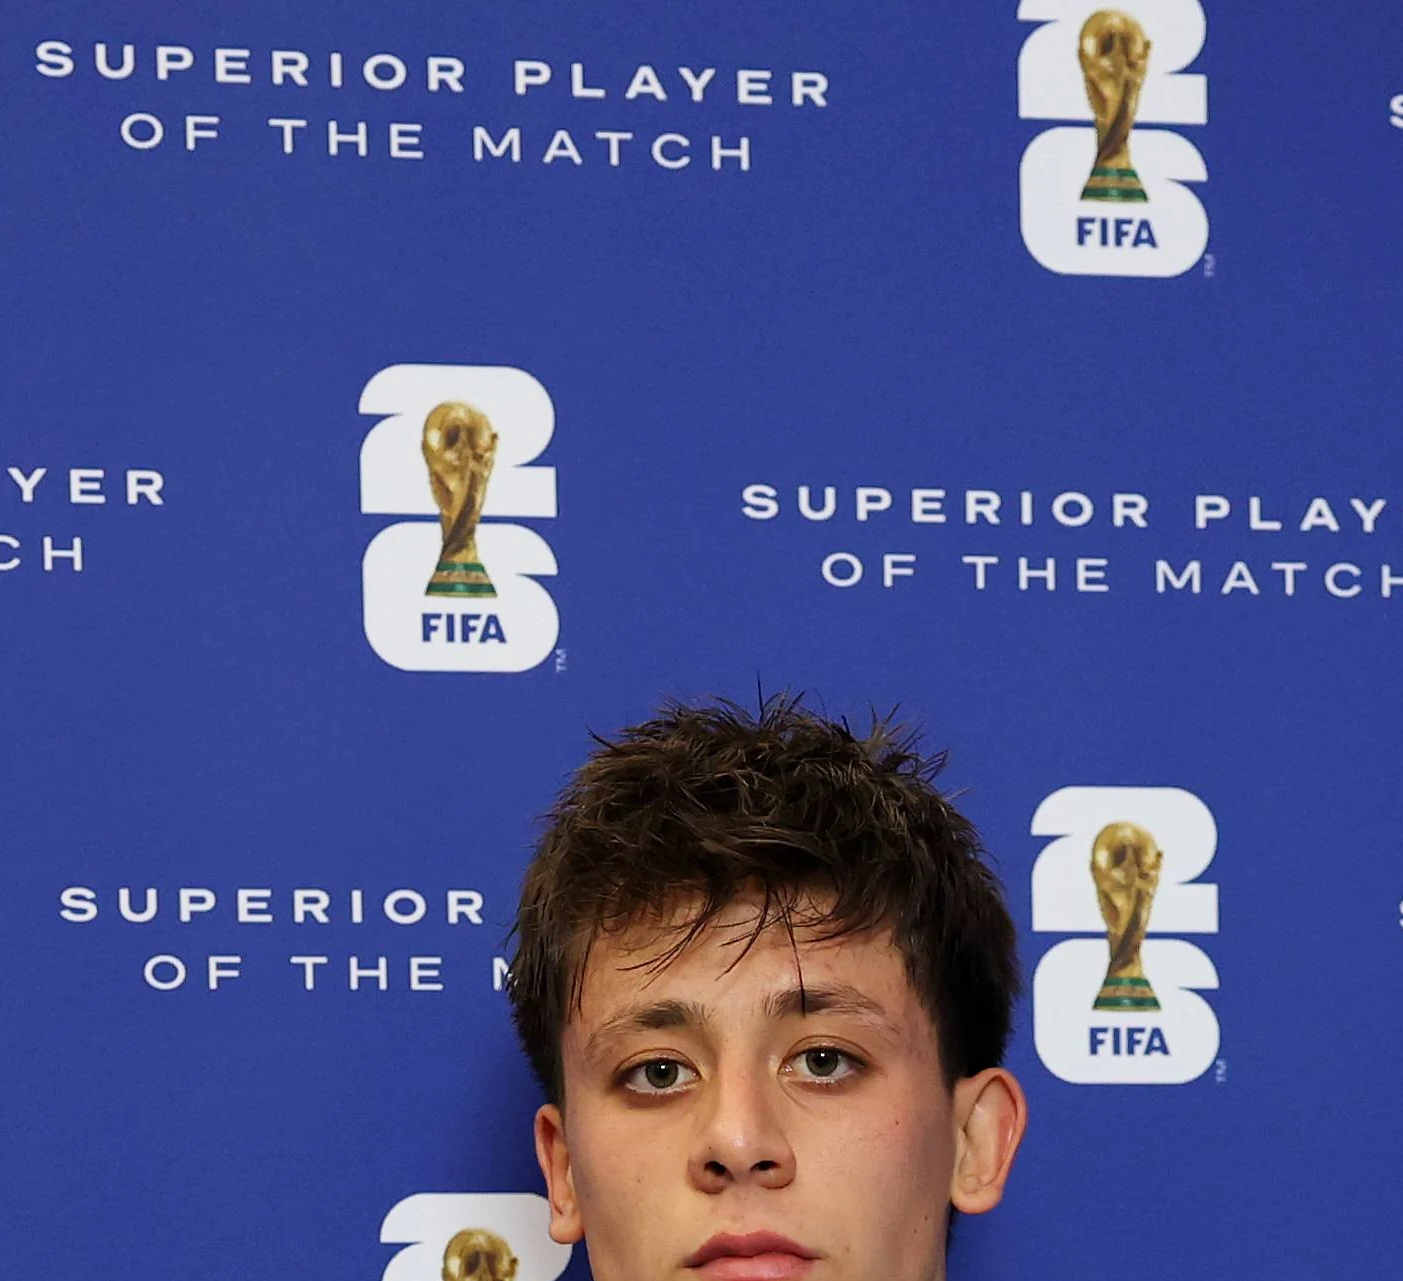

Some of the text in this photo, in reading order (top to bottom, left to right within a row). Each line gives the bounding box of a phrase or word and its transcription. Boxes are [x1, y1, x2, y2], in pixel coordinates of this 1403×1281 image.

[35, 40, 829, 108] SUPERIOR PLAYER
[119, 112, 751, 172] OF THE MATCH
[1076, 216, 1158, 249] FIFA
[740, 483, 1149, 529] SUPERIOR
[820, 551, 917, 589] OF
[961, 555, 1110, 593] THE
[421, 612, 508, 644] FIFA
[59, 886, 484, 926] SUPERIOR
[143, 954, 444, 992] OF THE
[1088, 1026, 1171, 1057] FIFA
